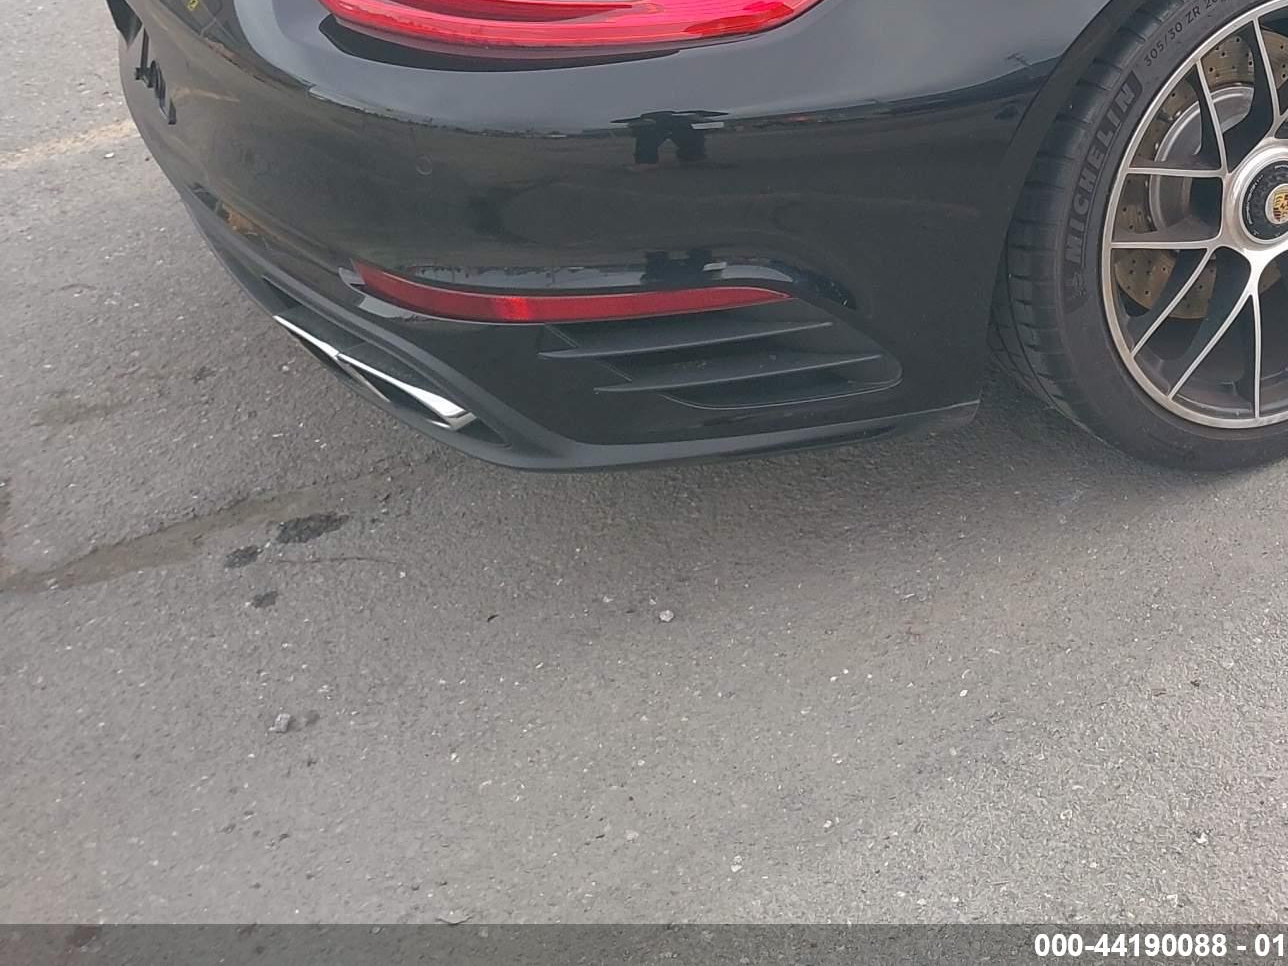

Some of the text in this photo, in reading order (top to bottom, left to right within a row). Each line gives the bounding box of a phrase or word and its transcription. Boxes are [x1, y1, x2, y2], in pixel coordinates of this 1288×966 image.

[1143, 21, 1183, 67] 305/30
[1185, 5, 1201, 25] ZR
[1064, 82, 1137, 265] MICHELIN
